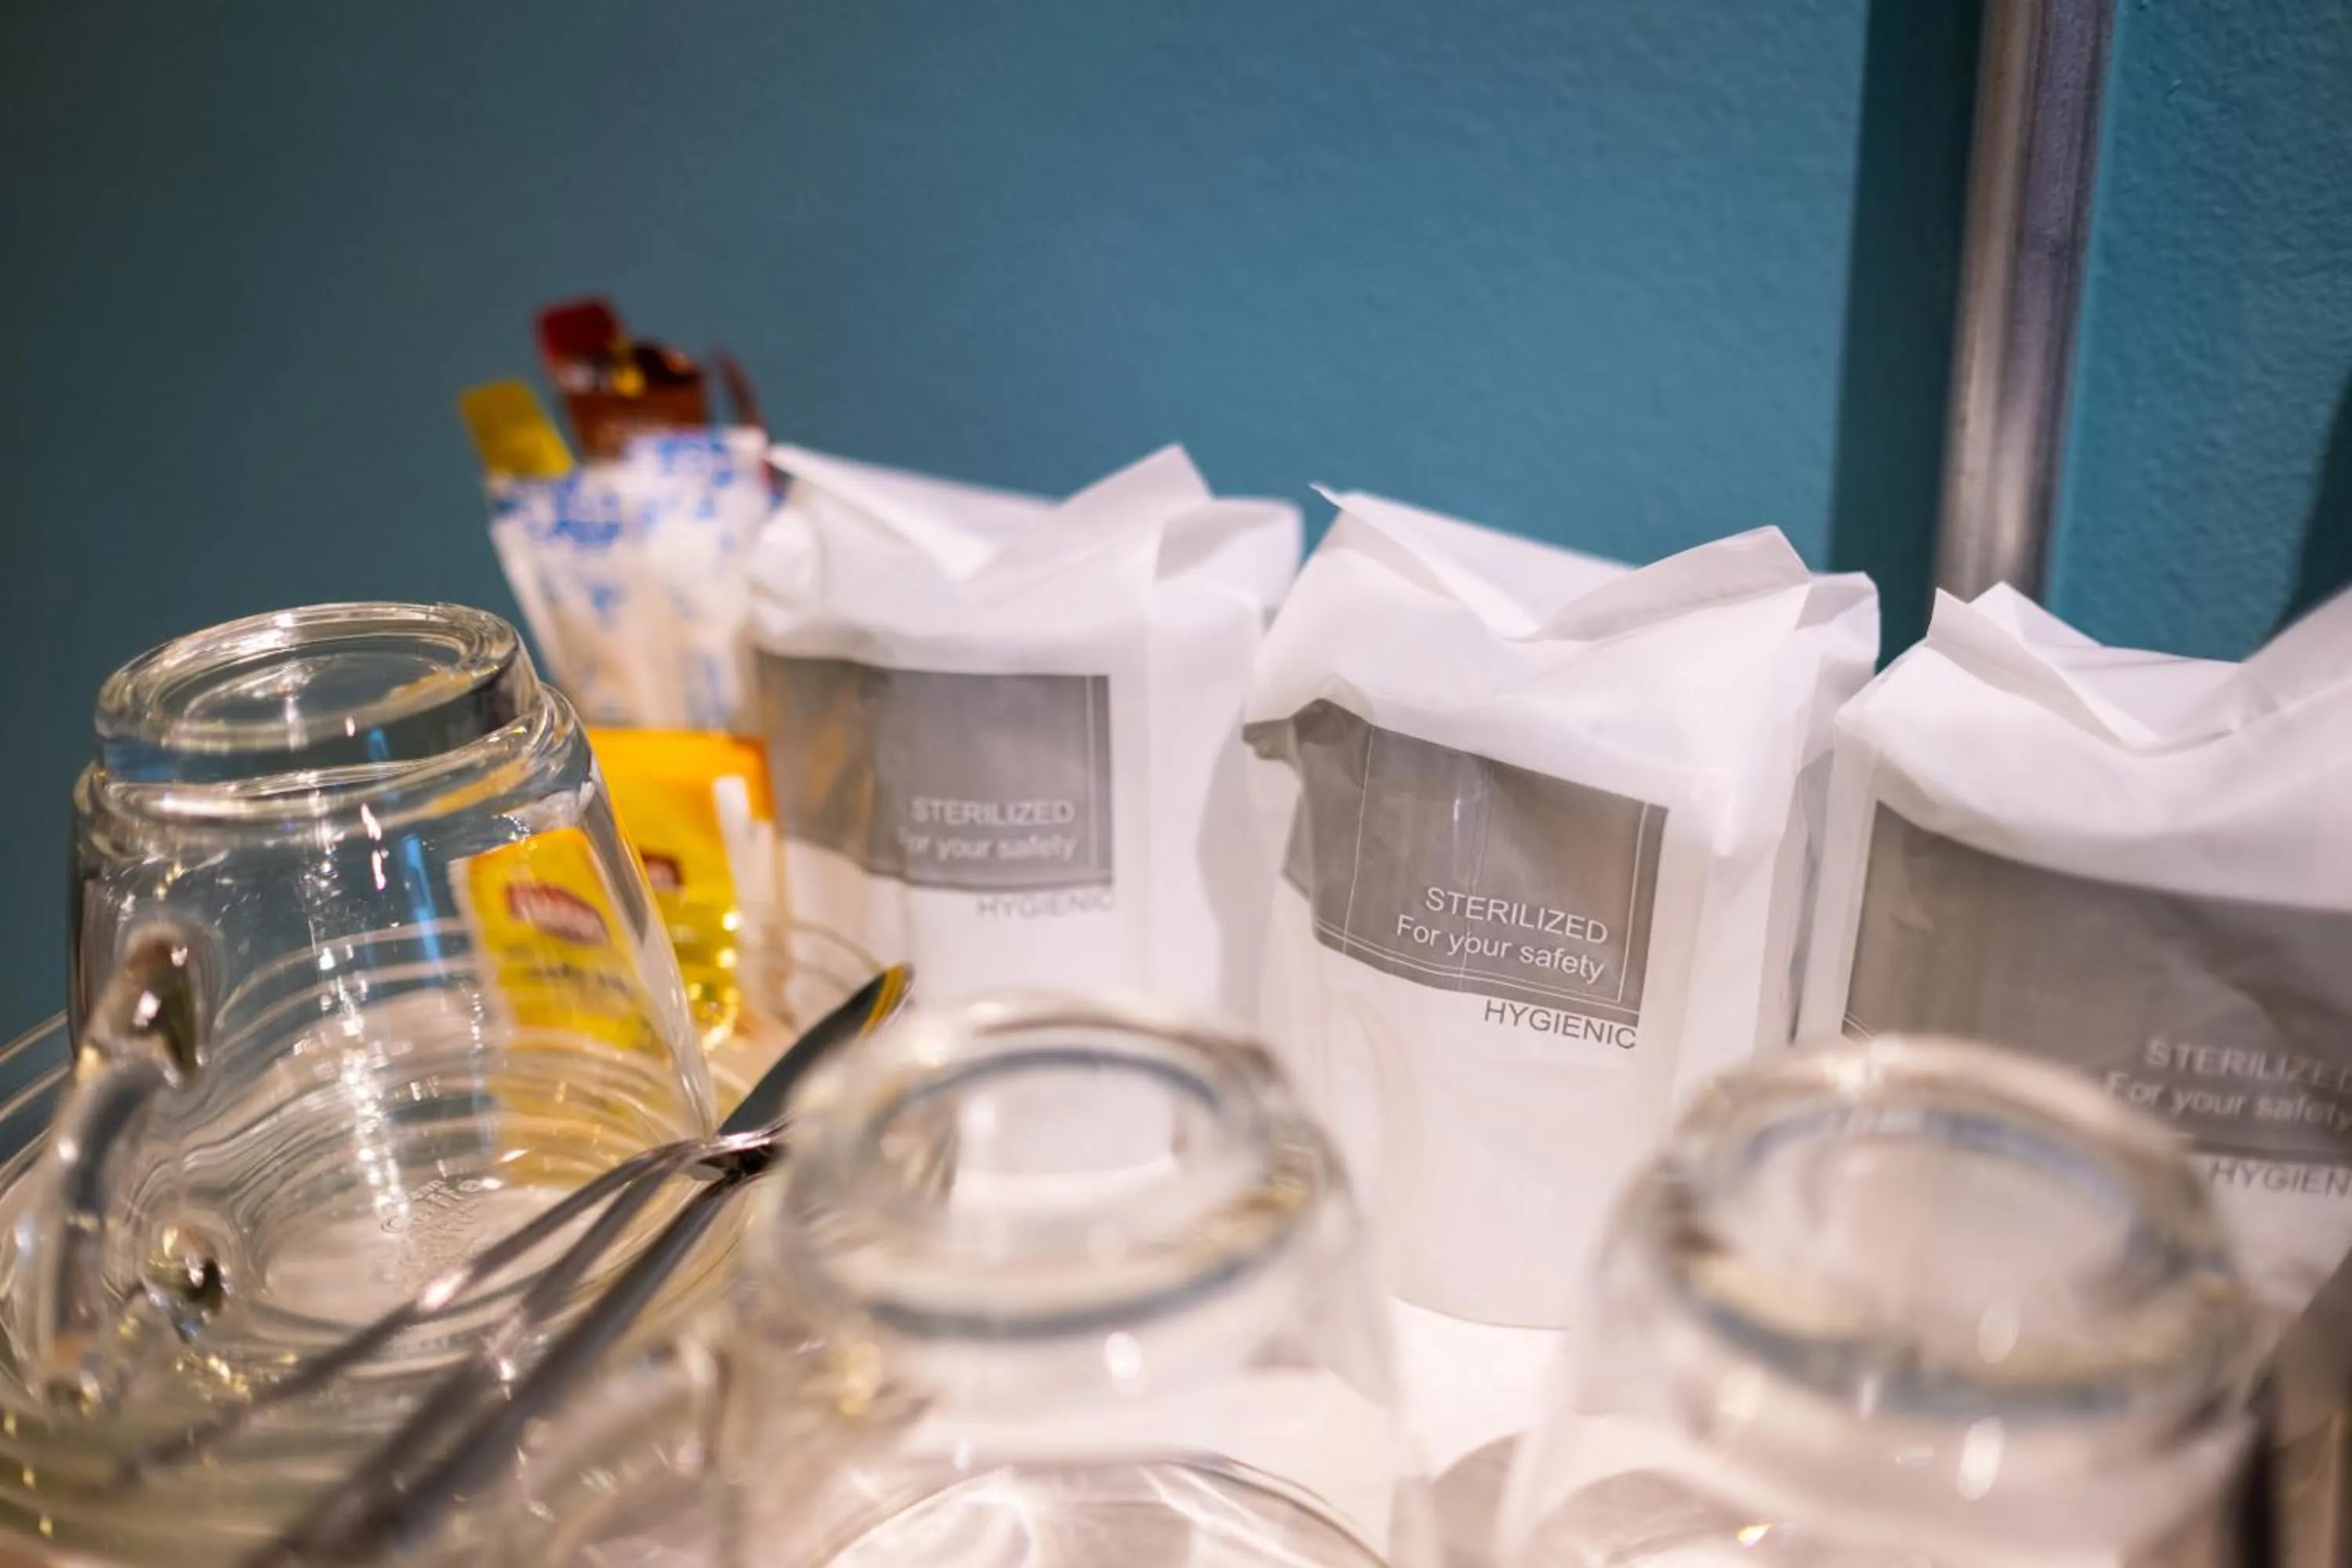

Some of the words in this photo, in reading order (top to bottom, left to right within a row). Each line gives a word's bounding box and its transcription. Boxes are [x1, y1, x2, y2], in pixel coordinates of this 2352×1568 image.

[910, 797, 1075, 825] STERILIZED
[936, 838, 991, 862] your
[1425, 886, 1608, 943] STERILIZED
[1397, 913, 1442, 946] For
[1447, 933, 1512, 958] your
[1519, 945, 1605, 984] safety
[1484, 1000, 1637, 1049] HYGIENIC
[2107, 1070, 2162, 1105] For
[2171, 1091, 2244, 1116] your
